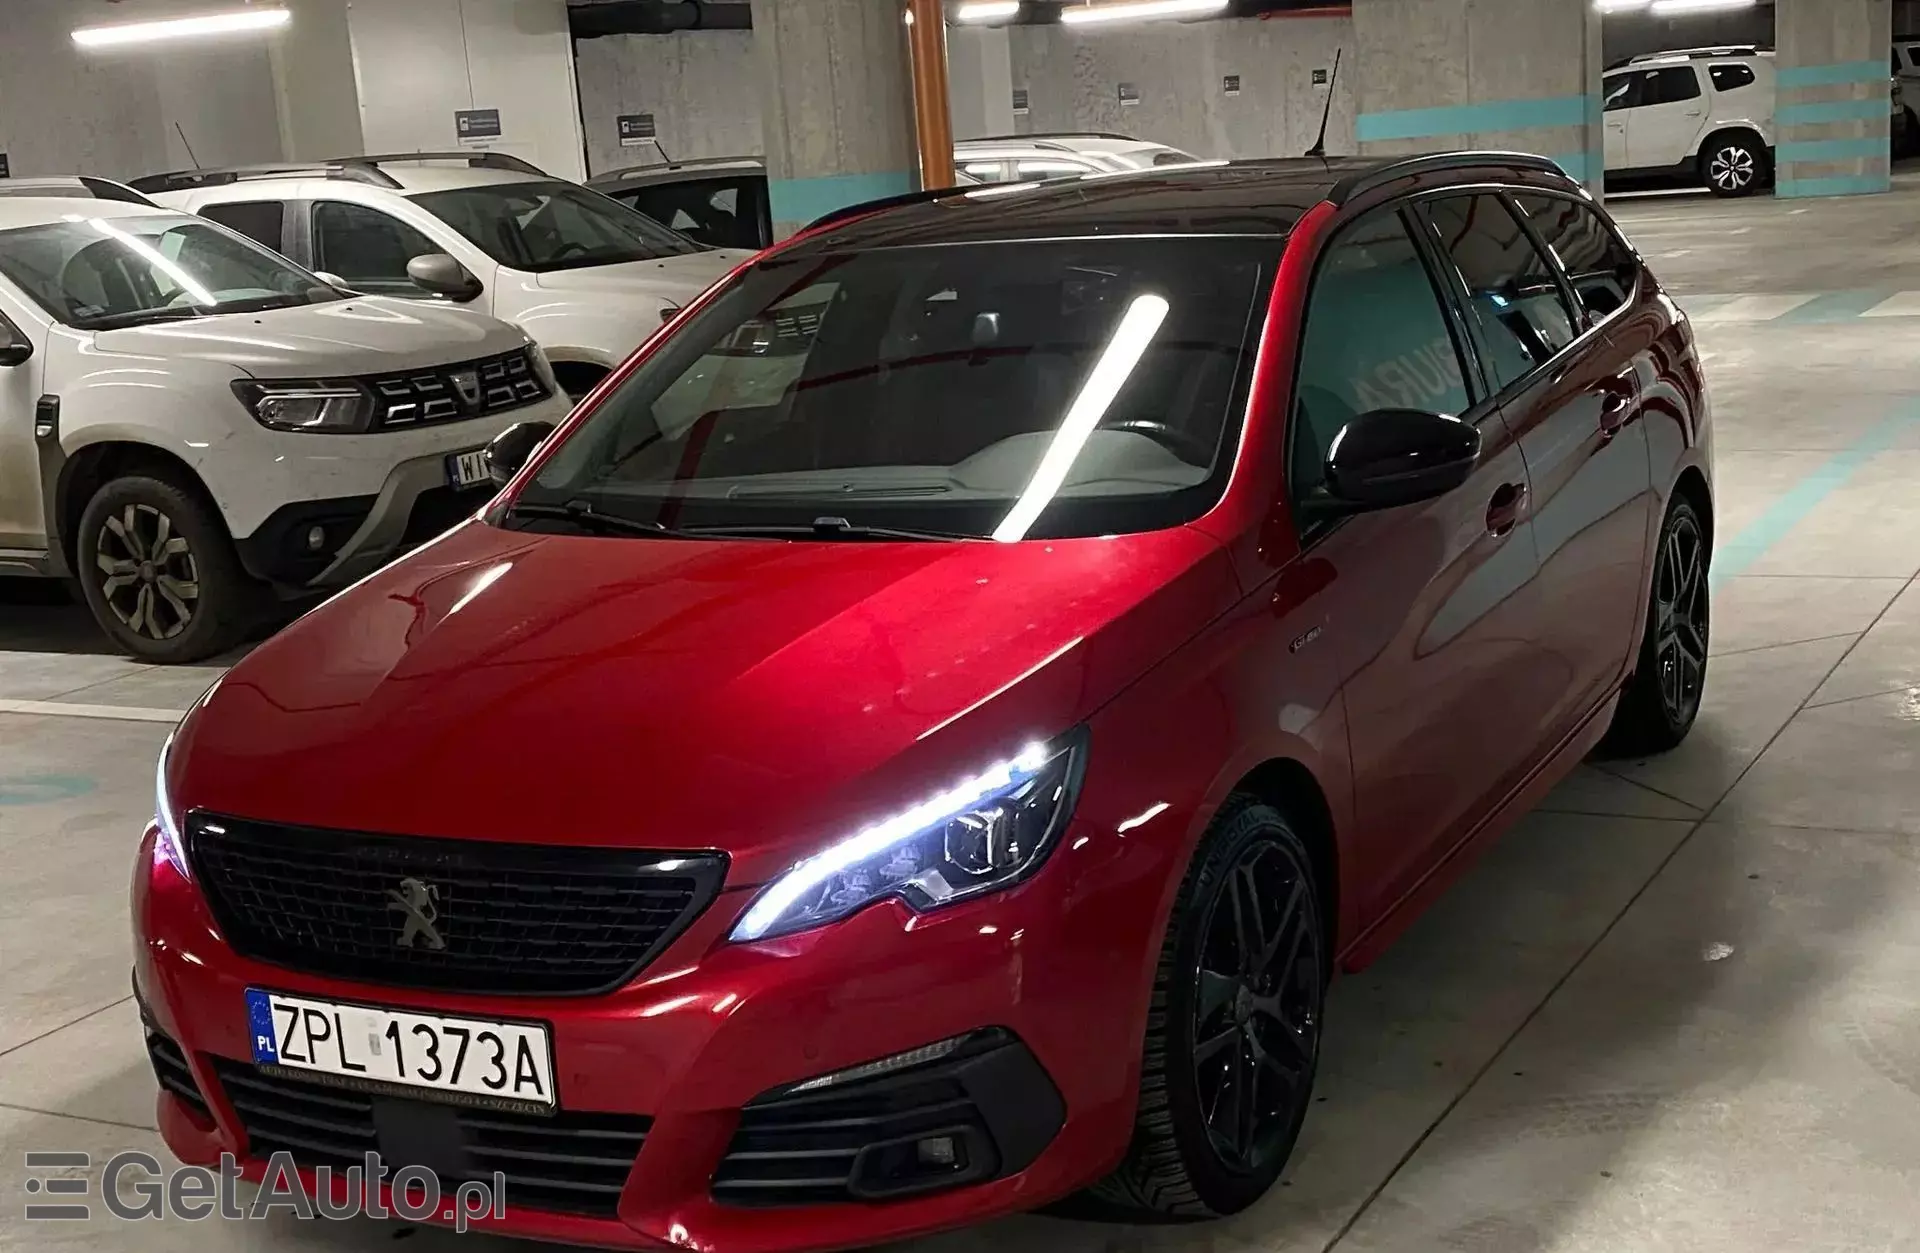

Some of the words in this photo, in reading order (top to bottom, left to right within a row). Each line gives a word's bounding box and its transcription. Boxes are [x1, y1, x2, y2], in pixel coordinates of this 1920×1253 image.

[257, 1035, 275, 1053] PL
[273, 1003, 367, 1073] ZPL
[385, 1020, 545, 1095] 1373A
